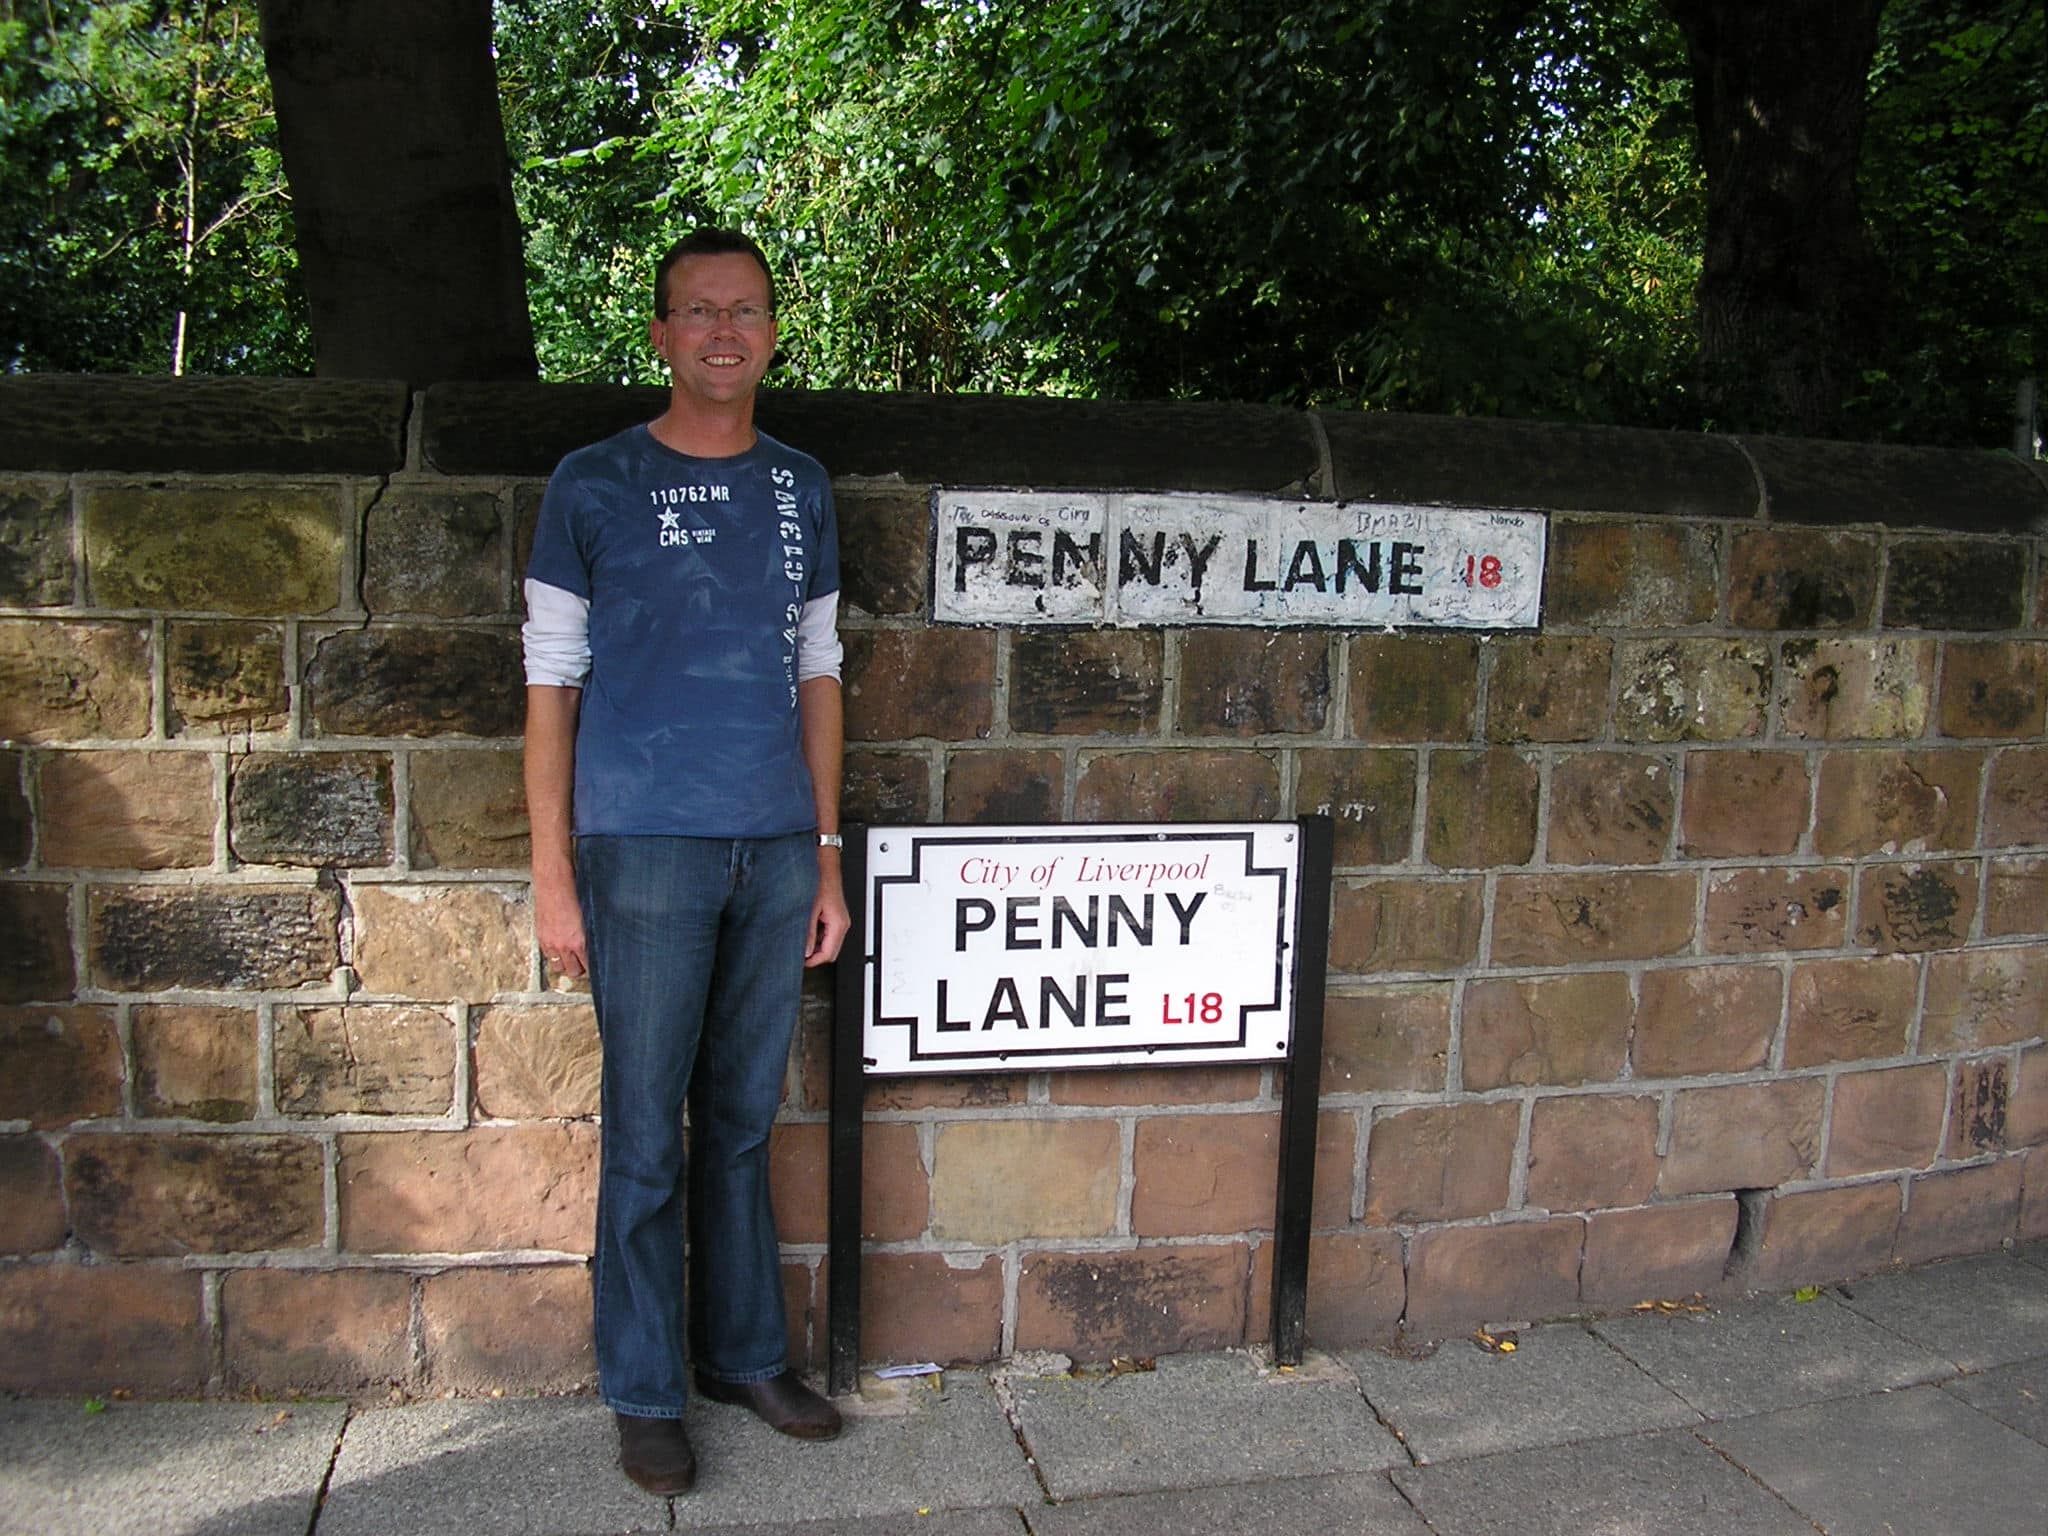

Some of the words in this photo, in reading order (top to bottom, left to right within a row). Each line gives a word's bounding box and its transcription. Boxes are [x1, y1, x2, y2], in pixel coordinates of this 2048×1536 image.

[650, 486, 707, 505] 110762
[710, 485, 730, 502] MR
[660, 529, 689, 547] CMS
[955, 525, 1223, 596] PENNY
[1243, 538, 1426, 595] LANE
[1465, 554, 1503, 588] 18
[960, 857, 1020, 891] City
[1030, 856, 1064, 891] of
[1077, 854, 1210, 889] Liverpool
[955, 892, 1209, 952] PENNY
[936, 974, 1131, 1033] LANE
[1162, 992, 1224, 1025] L18
